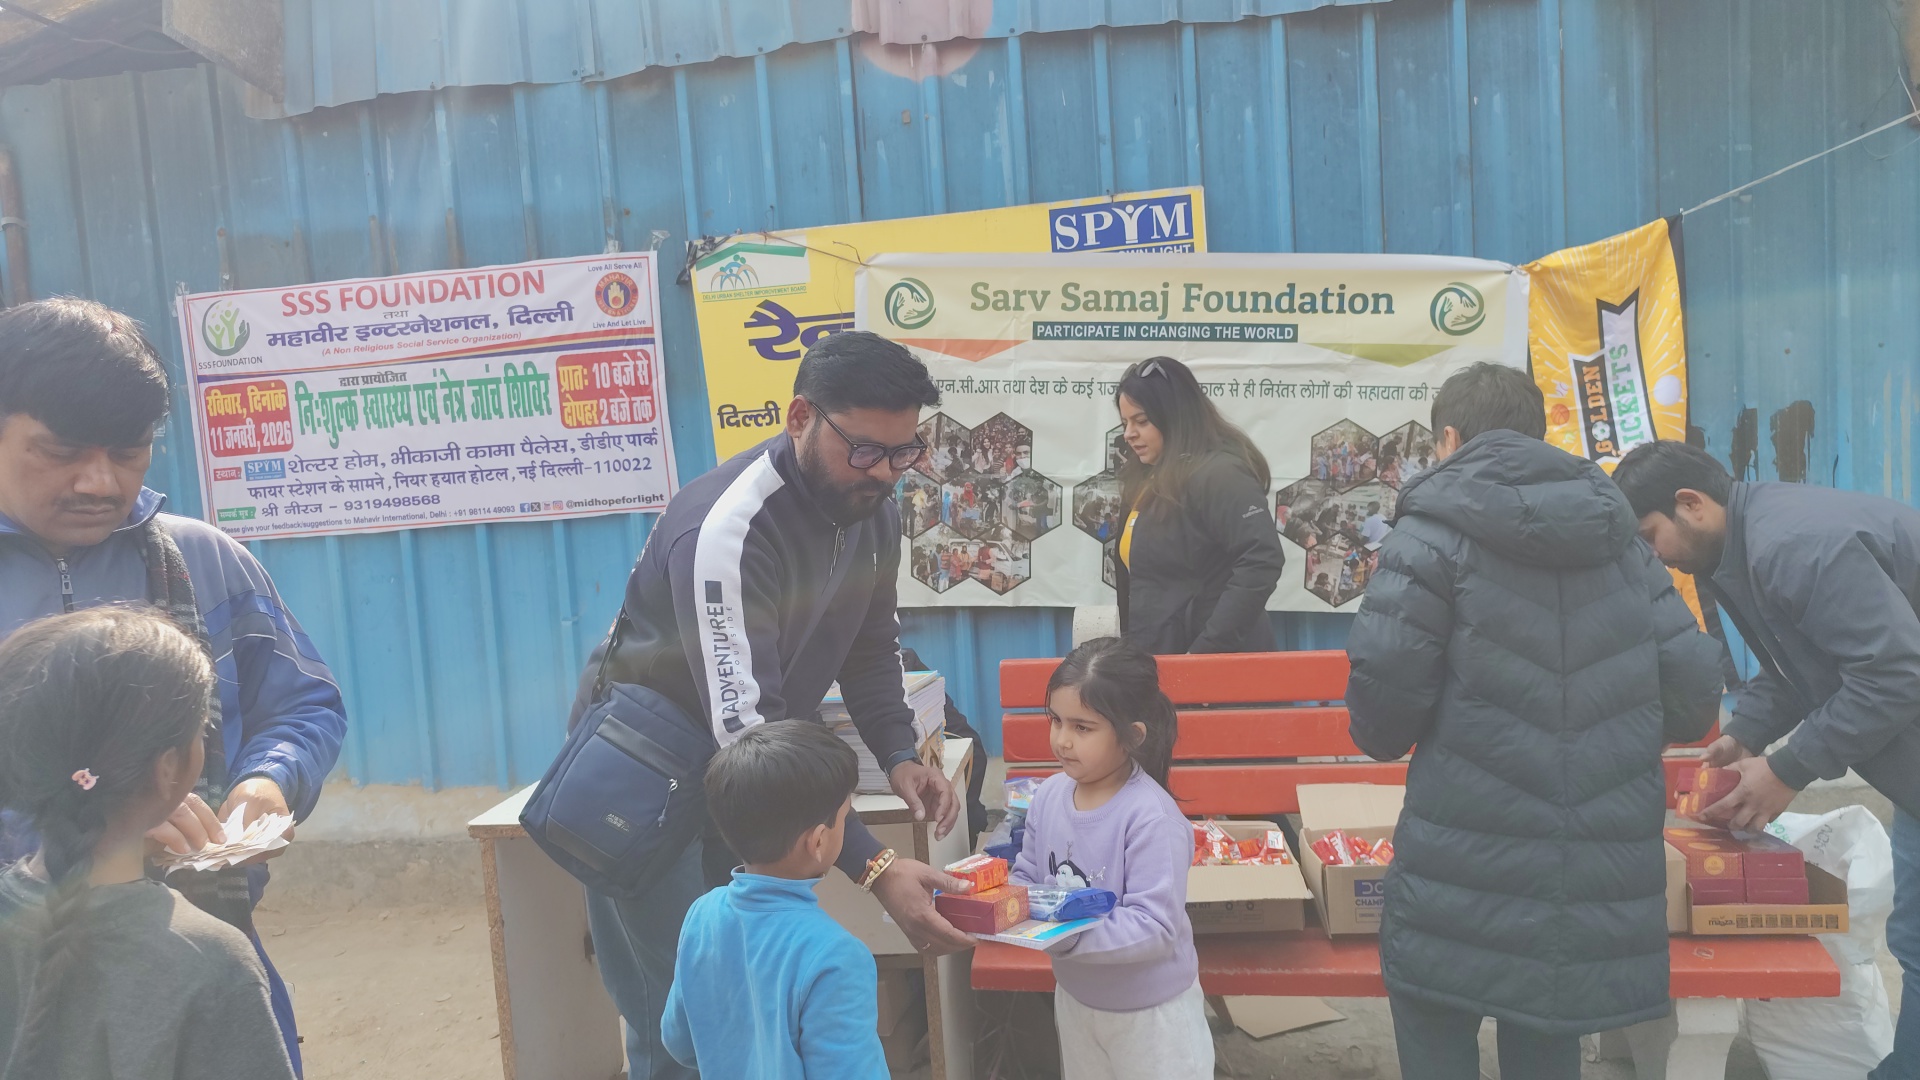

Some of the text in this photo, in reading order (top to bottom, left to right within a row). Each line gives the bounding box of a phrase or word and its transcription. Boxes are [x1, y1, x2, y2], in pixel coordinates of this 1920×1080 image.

[1054, 202, 1189, 250] SPYM
[588, 264, 603, 272] Love
[281, 269, 545, 317] SSS FOUNDATION
[970, 281, 1395, 320] Sarv Samaj Foundation
[266, 301, 574, 348] महावीर इन्टरनेशनल, दिल्ली
[382, 309, 409, 320] तथा
[607, 320, 619, 328] And
[621, 319, 631, 327] Let
[333, 347, 350, 355] Non
[353, 343, 394, 353] Religious
[397, 340, 424, 349] Social
[426, 337, 458, 347] Service
[462, 332, 522, 344] Organization)
[1037, 325, 1293, 339] PARTICIPATE IN CHANGING THE WORLD
[339, 370, 407, 387] द्वारा प्रायोजित
[592, 362, 610, 389] 10
[611, 352, 635, 387] बजे
[636, 351, 649, 386] से
[206, 382, 287, 419] रविवार, दिनांक
[360, 384, 414, 430] स्वास्थ्य
[413, 368, 440, 426] एवं
[440, 368, 467, 423] नेत्र
[467, 364, 504, 421] जांच
[503, 361, 552, 418] शिविर
[1003, 380, 1026, 395] तथा
[1029, 376, 1049, 395] देश
[1053, 376, 1068, 395] के
[1071, 377, 1094, 400] कई
[1229, 379, 1240, 398] से
[1243, 379, 1256, 399] ही
[1259, 378, 1297, 399] निरंतर
[1300, 380, 1331, 399] लोगों
[1333, 381, 1353, 400] की
[1356, 385, 1405, 401] सहायता
[1408, 382, 1428, 402] की
[1609, 344, 1645, 445] ICKETS
[562, 389, 653, 427] दोपहर 2 बजे तक
[716, 400, 781, 429] दिल्ली
[210, 417, 292, 453] 11 जनवरी, 2026
[288, 454, 339, 475] शेल्टर
[391, 441, 461, 466] भीकाजी
[466, 442, 515, 461] कामा
[578, 432, 625, 452] डीडीए
[626, 427, 659, 448] पार्क
[247, 460, 281, 473] SPYM
[247, 484, 285, 501] फायर
[286, 478, 327, 498] स्टेशन
[330, 475, 344, 494] के
[393, 472, 427, 489] नियर
[432, 468, 466, 488] हयात
[518, 460, 536, 482] नई
[261, 503, 279, 517] श्री
[284, 500, 323, 515] नीरज
[344, 494, 440, 511] 9319498568
[566, 494, 665, 509] @midhopeforlight
[221, 526, 240, 534] Please
[241, 525, 254, 534] give
[256, 524, 270, 533] your
[354, 515, 380, 524] Mahavir
[430, 511, 447, 519] Delhi
[454, 509, 467, 517] +91
[469, 507, 491, 516] 98114
[493, 505, 516, 514] 49093
[706, 605, 739, 715] ADVENTURE
[1355, 898, 1384, 906] CHAMP
